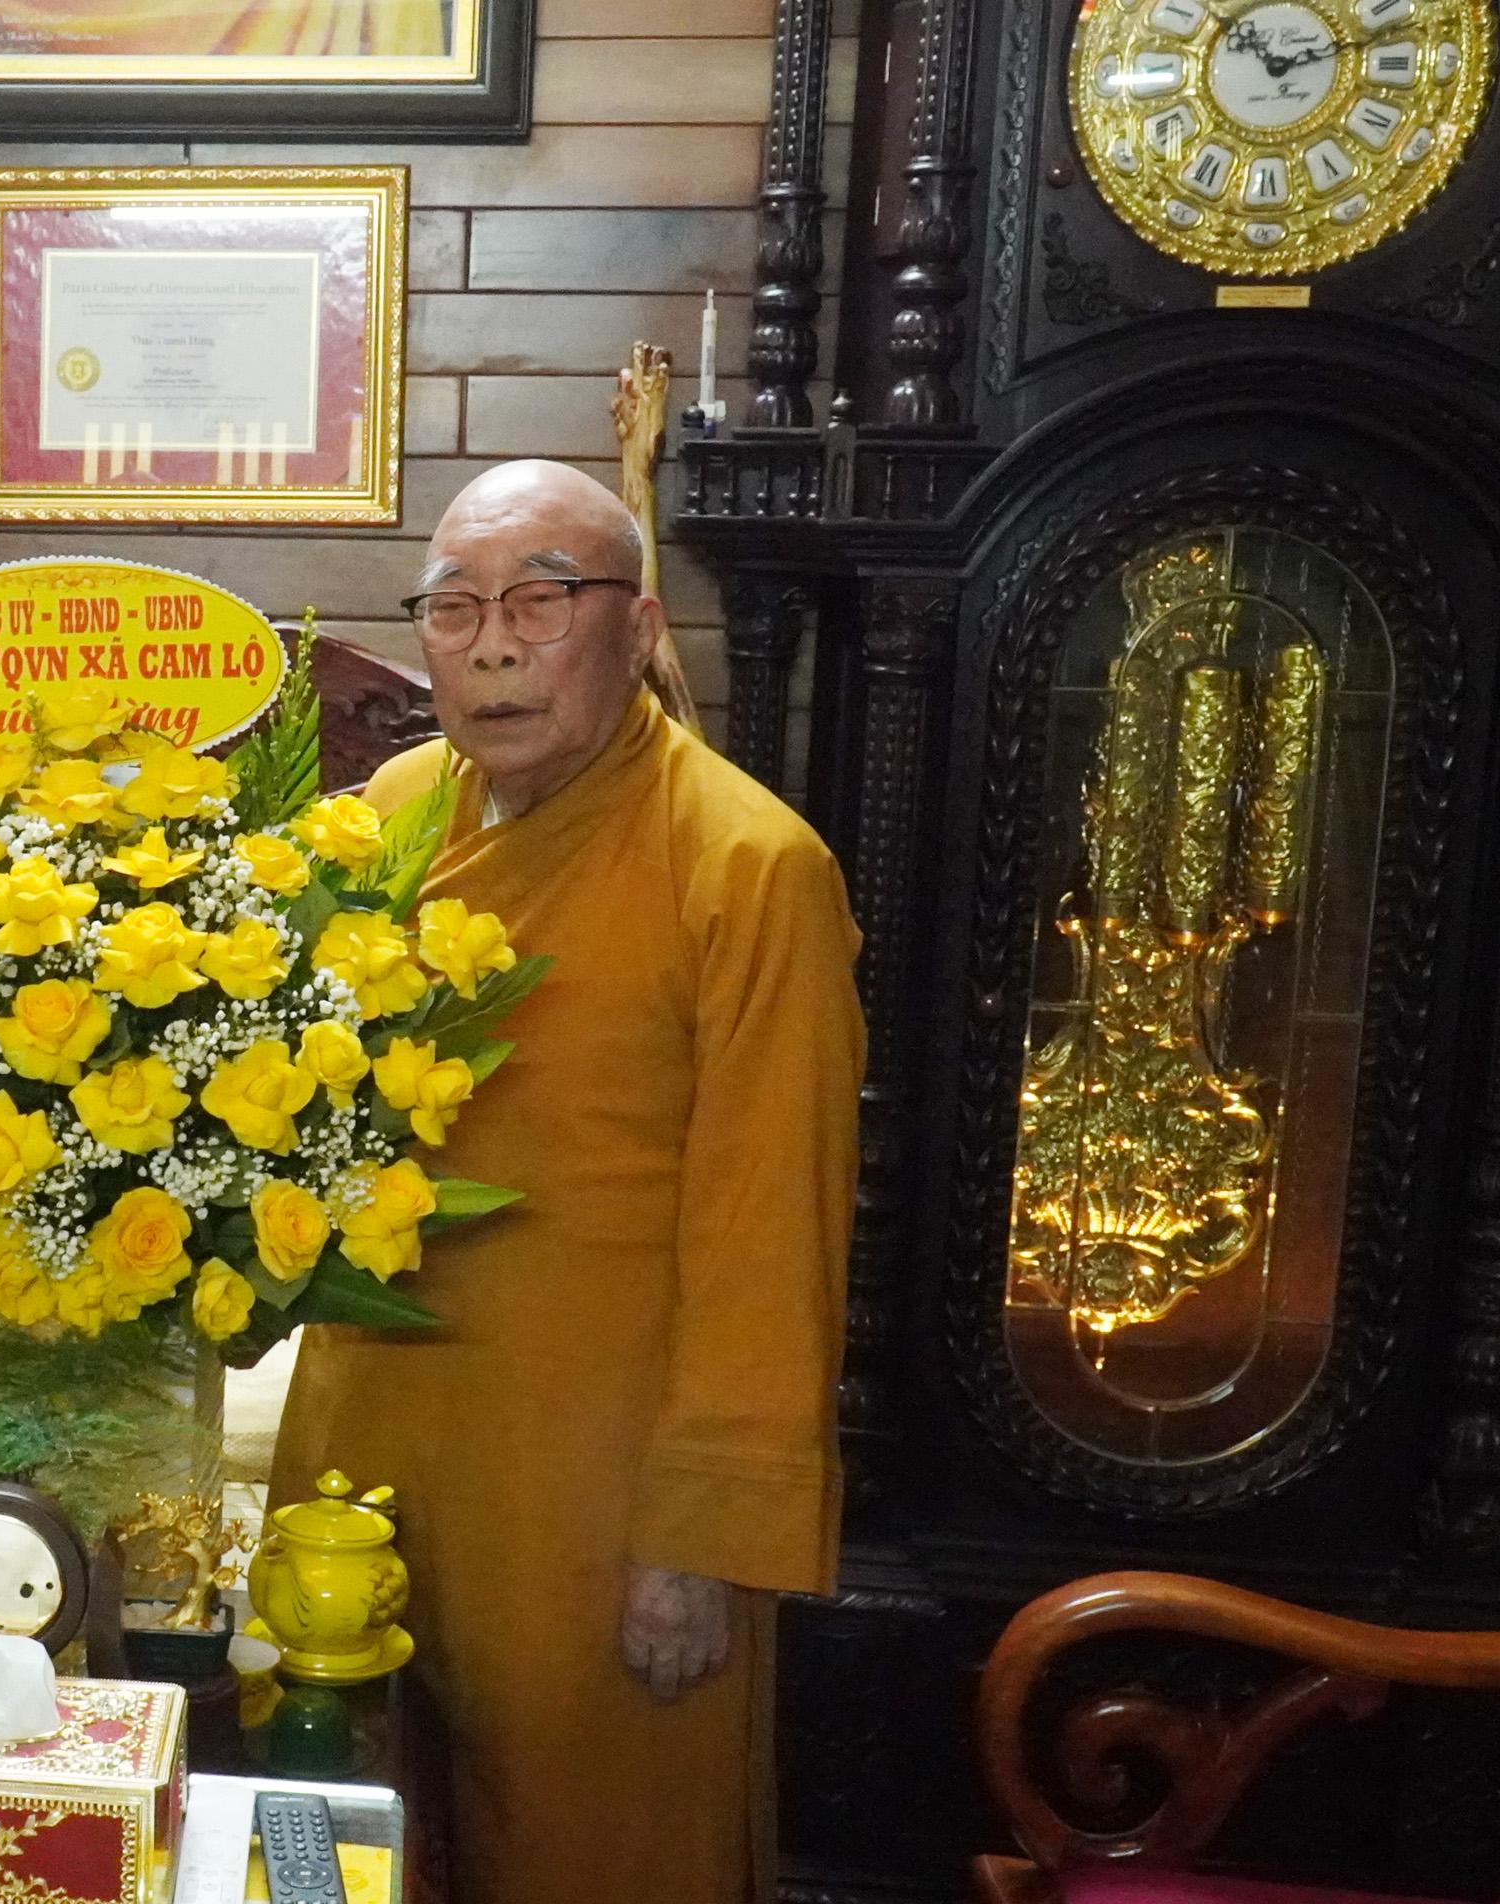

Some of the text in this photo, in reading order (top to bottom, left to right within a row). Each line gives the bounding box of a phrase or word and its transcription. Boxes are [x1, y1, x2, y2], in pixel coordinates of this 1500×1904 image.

[59, 597, 120, 634] HĐND
[145, 595, 204, 631] UBND
[79, 637, 128, 680] XÃ
[138, 643, 211, 680] CAM
[222, 634, 264, 687] LỘ
